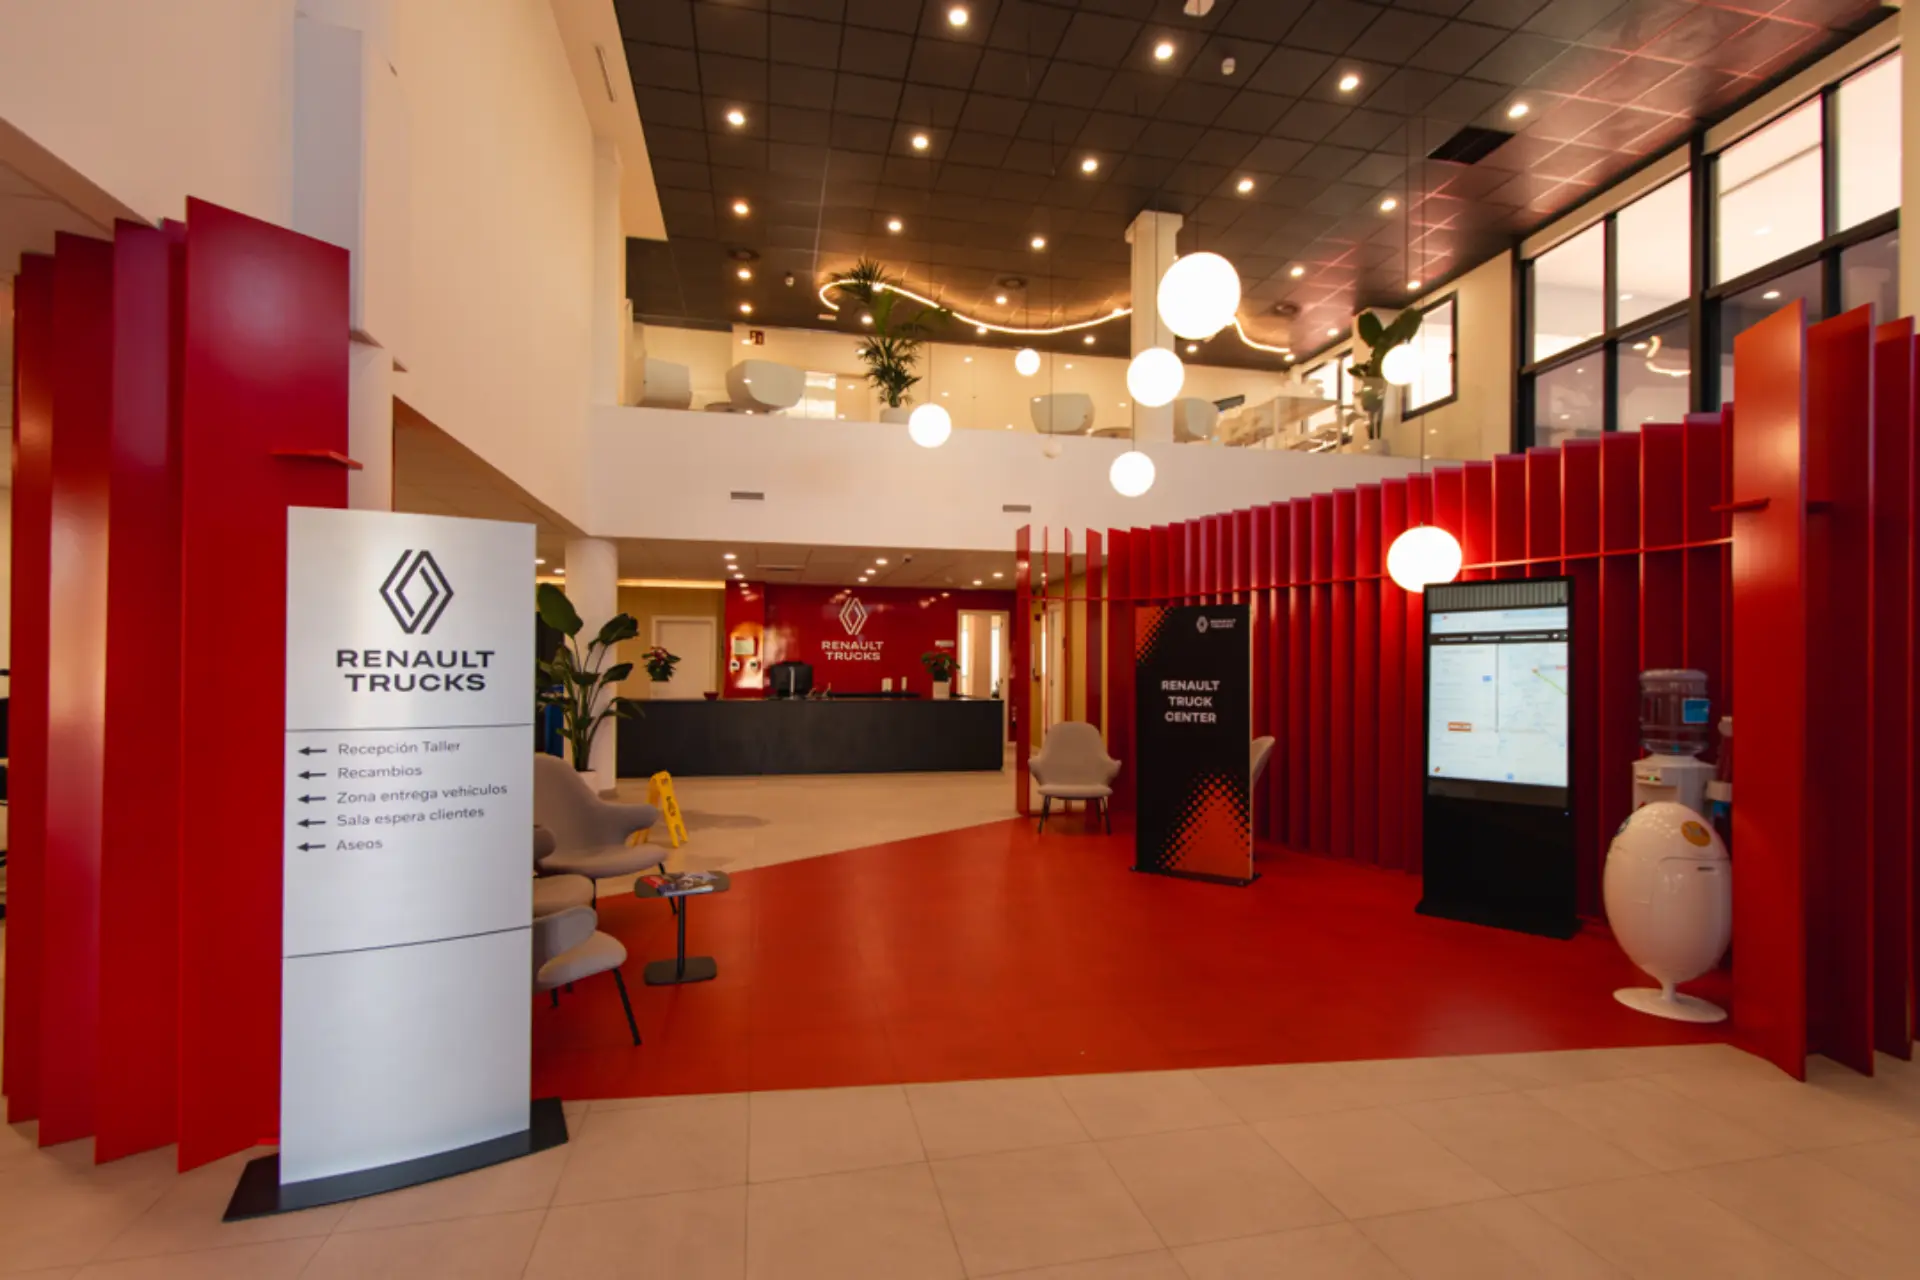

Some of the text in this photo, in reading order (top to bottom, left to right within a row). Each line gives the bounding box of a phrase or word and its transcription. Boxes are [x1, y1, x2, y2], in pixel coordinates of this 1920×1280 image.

[821, 641, 884, 650] RENAULT
[336, 650, 495, 668] RENAULT
[825, 652, 880, 660] TRUCKS
[344, 673, 486, 692] TRUCKS
[1161, 680, 1220, 691] RENAULT
[1168, 696, 1213, 707] TRUCK
[1164, 711, 1216, 723] CENTER
[338, 741, 461, 757] Recepción Taller
[338, 765, 423, 779] Recambios
[337, 791, 376, 804] Zona
[380, 788, 438, 804] entrega
[337, 806, 485, 827] Sala espera clientes
[336, 839, 383, 851] Aseos
